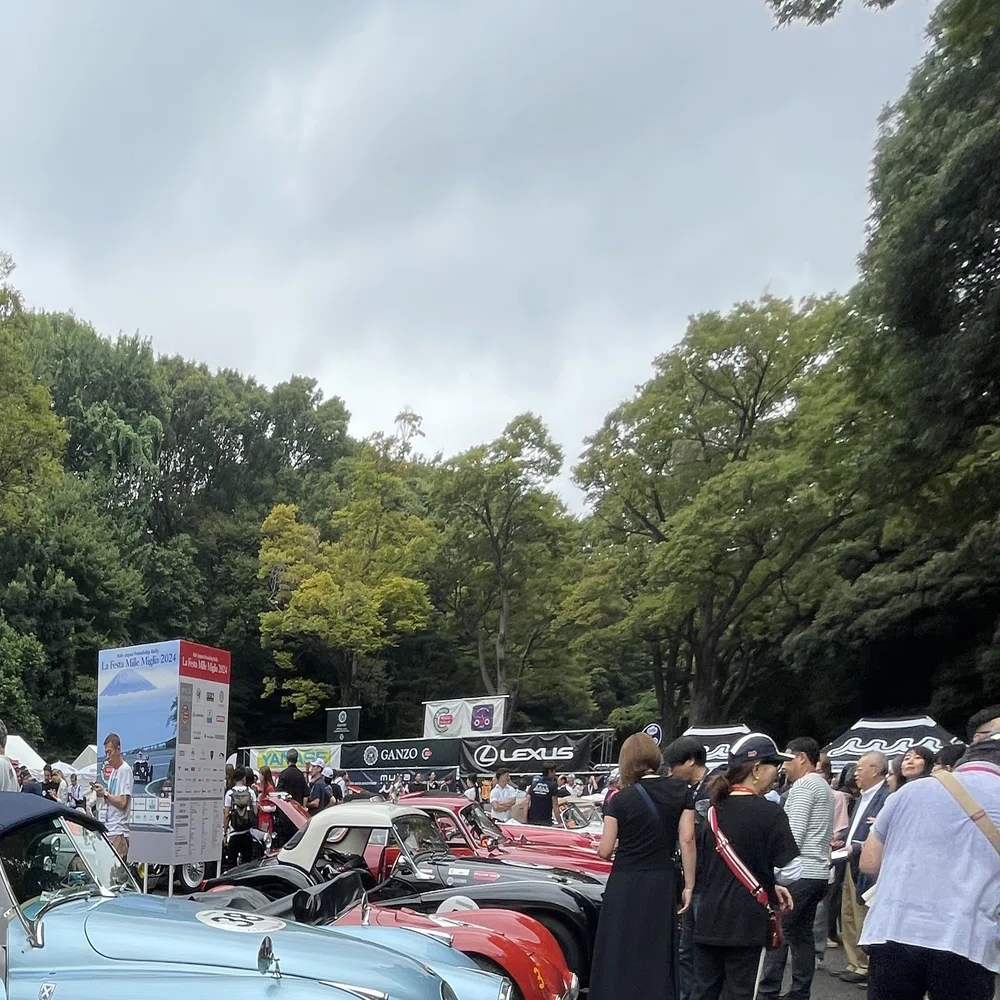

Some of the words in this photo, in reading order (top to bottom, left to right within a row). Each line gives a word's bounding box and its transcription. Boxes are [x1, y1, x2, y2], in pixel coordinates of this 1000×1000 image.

[101, 661, 109, 671] La
[109, 659, 125, 670] Festa
[125, 657, 140, 668] Mille
[140, 655, 160, 668] Miglia
[160, 653, 177, 664] 2024
[182, 656, 188, 667] La
[381, 748, 418, 761] GANZO
[500, 746, 574, 762] LEXUS
[211, 912, 265, 927] 38
